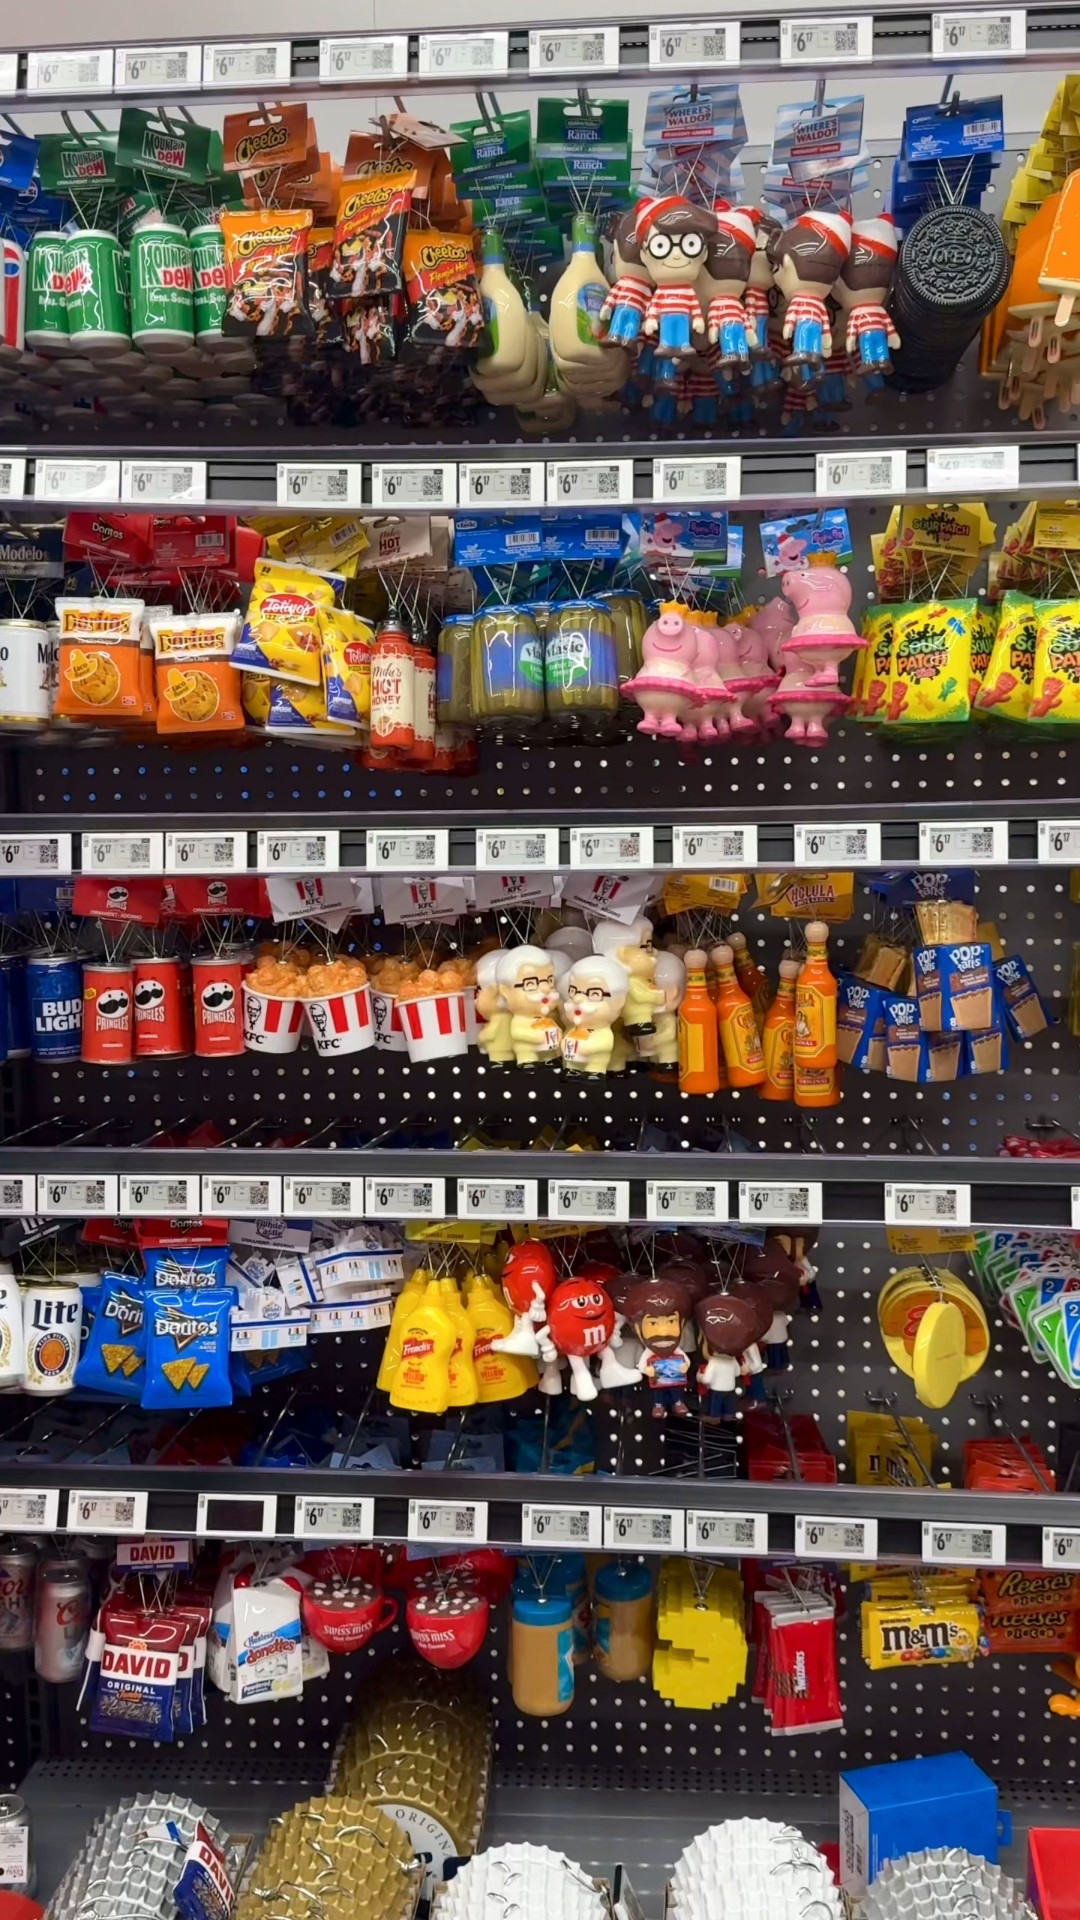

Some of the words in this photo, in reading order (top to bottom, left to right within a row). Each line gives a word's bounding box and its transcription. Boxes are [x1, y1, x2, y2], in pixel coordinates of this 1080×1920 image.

[668, 105, 710, 117] WHERE'S
[668, 113, 710, 126] WALDO?
[796, 119, 837, 134] WHERE'S
[567, 129, 599, 140] Ranch
[796, 129, 838, 143] WALDO?
[235, 127, 289, 164] Cheetos
[476, 147, 504, 158] Ranch
[573, 159, 604, 170] Ranch
[344, 188, 393, 217] Cheetos
[238, 226, 293, 256] Cheetos
[421, 244, 468, 268] Cheetos
[933, 249, 972, 264] OREO
[92, 522, 124, 541] Doritos
[912, 518, 939, 531] SOUR
[940, 522, 970, 536] PATCH
[379, 537, 400, 552] HOT
[264, 597, 315, 615] Totino's
[64, 610, 130, 633] Doritos
[158, 628, 225, 652] Doritos
[899, 636, 945, 654] SOUR
[372, 661, 402, 677] Mike's
[898, 653, 948, 673] PATCH
[372, 679, 401, 696] HOT
[372, 695, 401, 706] HONEY
[594, 895, 608, 904] KFC
[42, 1000, 81, 1016] BUD
[135, 1006, 164, 1022] PRINGLES
[203, 1008, 235, 1024] PRINGLES
[36, 1015, 81, 1032] LIGH
[96, 1016, 128, 1031] PRINGLES
[243, 1031, 265, 1044] KFC
[318, 1039, 340, 1050] KFC
[170, 1219, 203, 1228] Doritos
[156, 1271, 216, 1287] Doritos
[1045, 1281, 1055, 1292] 2
[31, 1299, 78, 1330] Lite
[105, 1301, 144, 1325] Dorit
[1070, 1305, 1079, 1316] 2
[156, 1318, 218, 1336] Doritos
[1042, 1321, 1052, 1332] 1
[583, 1325, 606, 1346] m
[403, 1342, 433, 1356] French's
[44, 1368, 60, 1376] BEER
[130, 1546, 175, 1561] DAVID
[999, 1571, 1074, 1597] Reese's
[1011, 1593, 1061, 1605] PIECES
[248, 1632, 275, 1645] Hostess
[881, 1622, 959, 1652] m&m's
[1006, 1628, 1056, 1638] PIECES
[247, 1638, 295, 1663] donettes
[102, 1651, 171, 1678] DAVID
[107, 1681, 155, 1695] ORIGINAL
[395, 1808, 453, 1860] ORIGINA
[199, 1846, 235, 1907] DAVI
